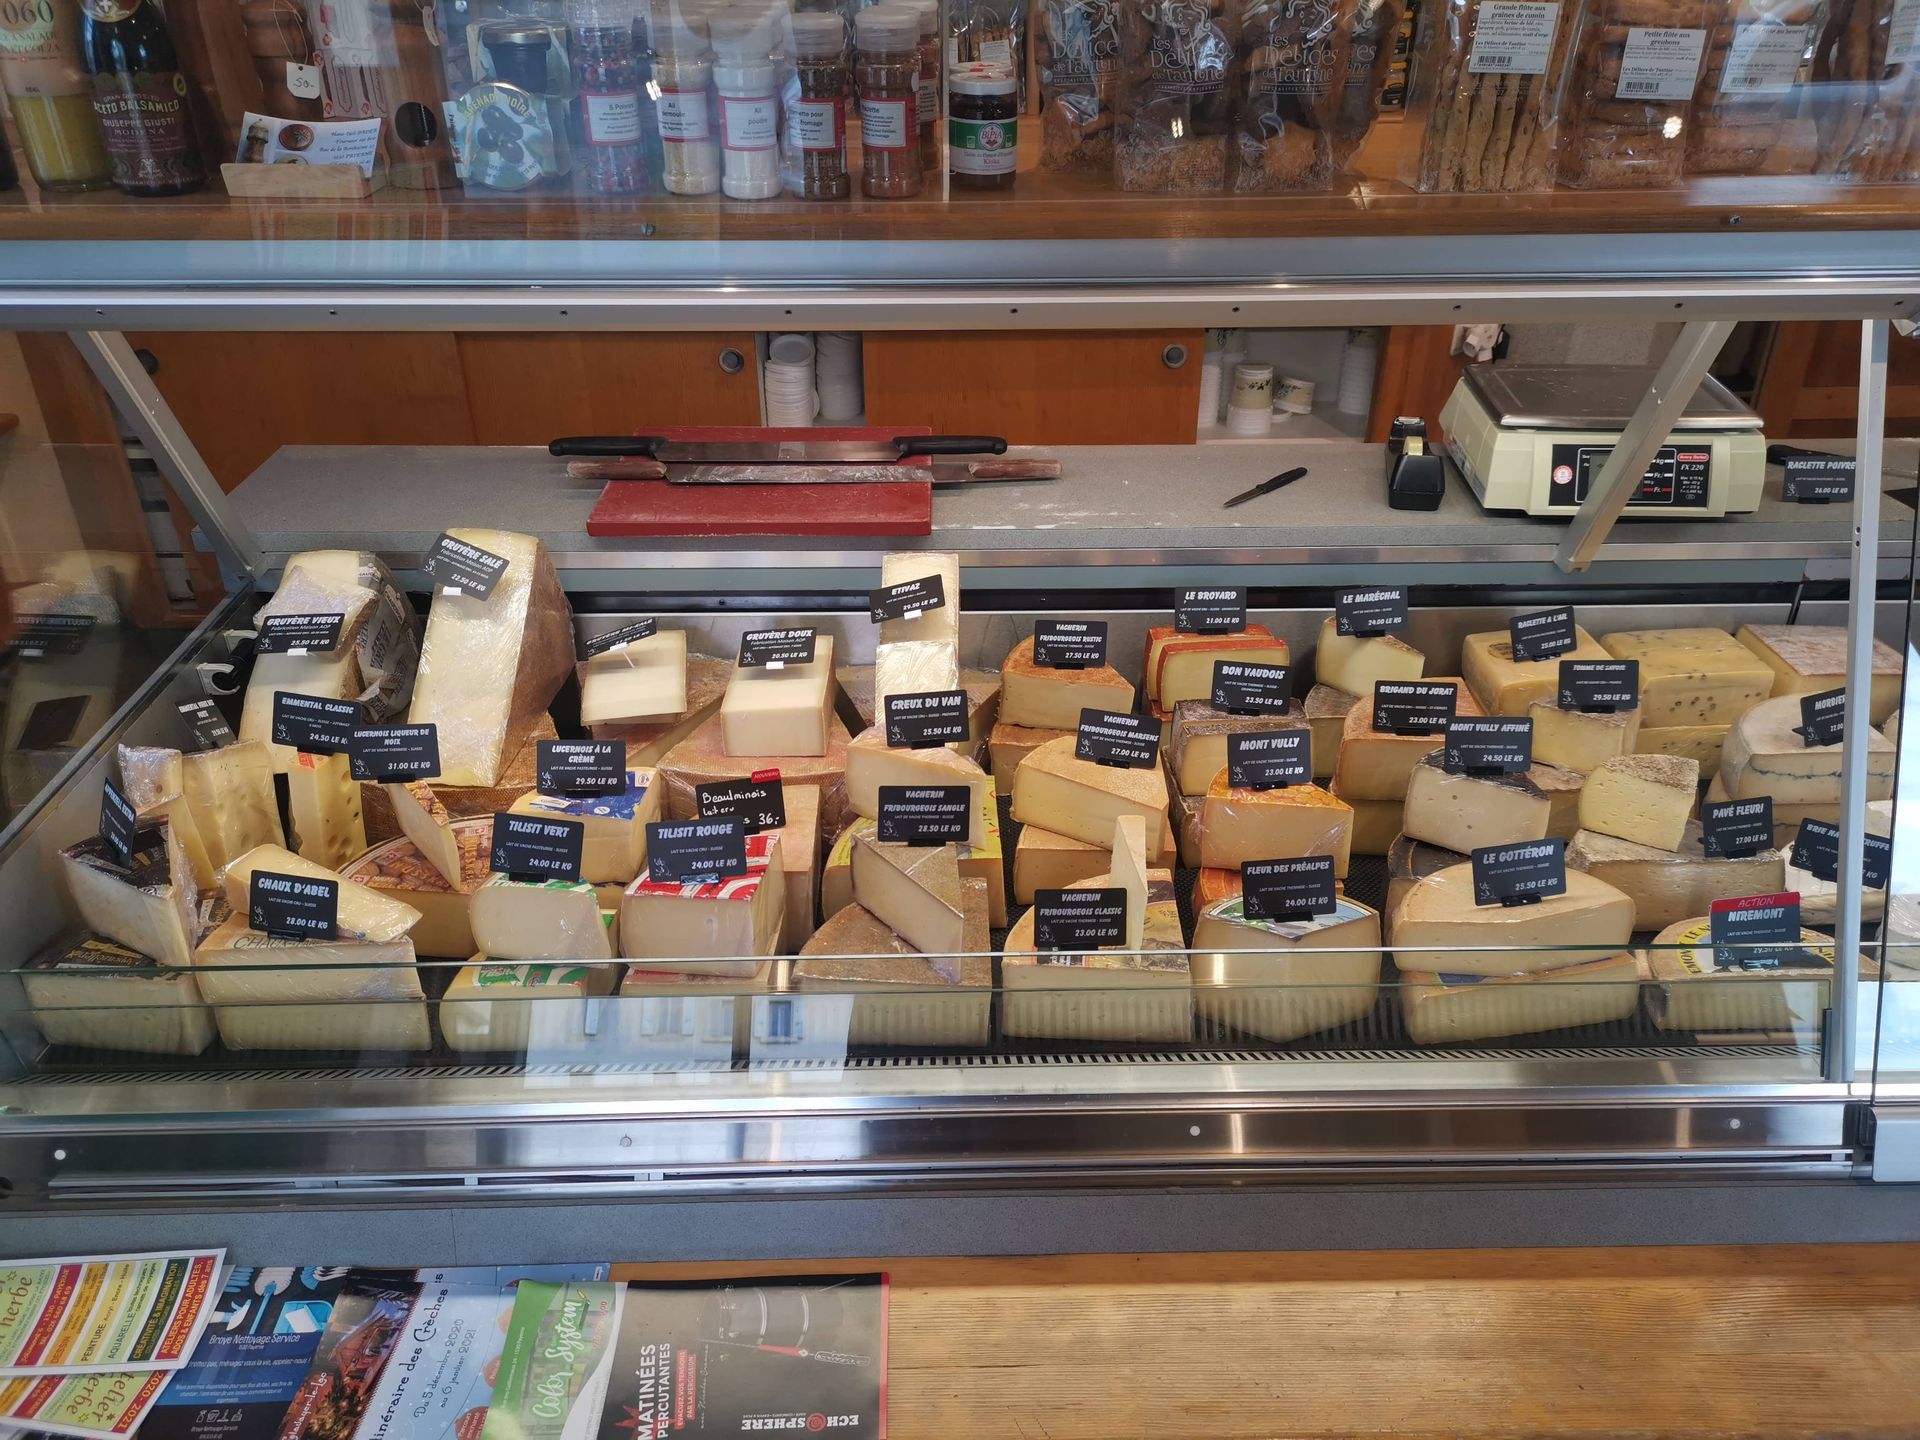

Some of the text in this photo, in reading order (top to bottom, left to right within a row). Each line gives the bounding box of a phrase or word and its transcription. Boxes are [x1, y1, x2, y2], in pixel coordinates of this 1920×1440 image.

[120, 99, 180, 112] BALSAMICO
[1787, 461, 1826, 469] RACLETTE
[1185, 591, 1237, 600] LE BROYARD
[1343, 590, 1400, 603] LE MARÉCHAL
[267, 616, 341, 626] GRUYÈRE VIEUX
[747, 630, 813, 640] GRUYÈRE DOUX
[1222, 666, 1285, 679] BON VAUDOIS
[1380, 686, 1415, 694] BRIGAND
[1428, 687, 1454, 696] JORAT
[282, 697, 355, 714] EMMENTAL CLASSIC
[891, 696, 961, 710] CREUX DU VAN
[1103, 715, 1139, 726] VACHERIN
[1450, 722, 1531, 732] MONT VULLY AFFINÉ
[309, 733, 330, 742] 24.50
[354, 729, 389, 737] LUCERNOIS
[923, 728, 942, 736] 25.50
[1080, 724, 1159, 742] FRIBOURGEOIS MARSENS
[384, 738, 401, 746] NOIX
[551, 745, 593, 753] LUCERNOIS
[594, 744, 600, 753] À
[1240, 738, 1300, 751] MONT VULLY
[568, 754, 595, 763] CRÈME
[1111, 748, 1130, 757] 27.00
[388, 762, 409, 770] 31.00
[905, 790, 944, 798] VACHERIN
[884, 804, 936, 812] FRIBOURGEOIS
[1712, 803, 1764, 818] PAVÉ FLEURI
[509, 820, 570, 837] TILISIT VERT
[658, 823, 733, 839] TILISIT ROUGE
[1806, 824, 1826, 834] BRIE
[1483, 844, 1554, 864] LE GOTTÉRON
[529, 858, 572, 870] 24.00 LE KG
[691, 858, 737, 870] 24.00 LE KG
[1247, 861, 1330, 875] FLEUR DES PRÉALPES
[258, 878, 330, 898] CHAUX D'ABEL
[1061, 893, 1101, 902] VACHERIN
[1286, 898, 1306, 907] 24.00
[1738, 896, 1775, 908] ACTION
[1040, 907, 1122, 916] FRIBOURGEOIS CLASSIC
[1728, 908, 1785, 922] NIREMONT
[286, 916, 328, 929] 28.00 LE KG
[1075, 929, 1096, 937] 23.00
[1108, 928, 1118, 936] KG
[157, 1263, 178, 1311] IMAGINATION
[161, 1320, 182, 1353] ATELIERS
[177, 1300, 190, 1319] POUR
[171, 1332, 186, 1354] ADOS
[184, 1294, 202, 1328] ENFANTS
[399, 1289, 448, 1371] des Crèches
[108, 1312, 136, 1359] AQUARELLE
[209, 1333, 301, 1345] Broye Nettoyage Service
[81, 1323, 106, 1362] PEINTURE
[532, 1300, 584, 1418] Color System
[414, 1402, 429, 1417] Du
[427, 1350, 451, 1389] décembre
[445, 1319, 464, 1347] 2020
[441, 1330, 476, 1408] au 6 janvier 2021
[635, 1344, 656, 1440] MATINÉES
[657, 1343, 670, 1438] PERCUTANTES
[117, 1371, 164, 1429] 2020 2021
